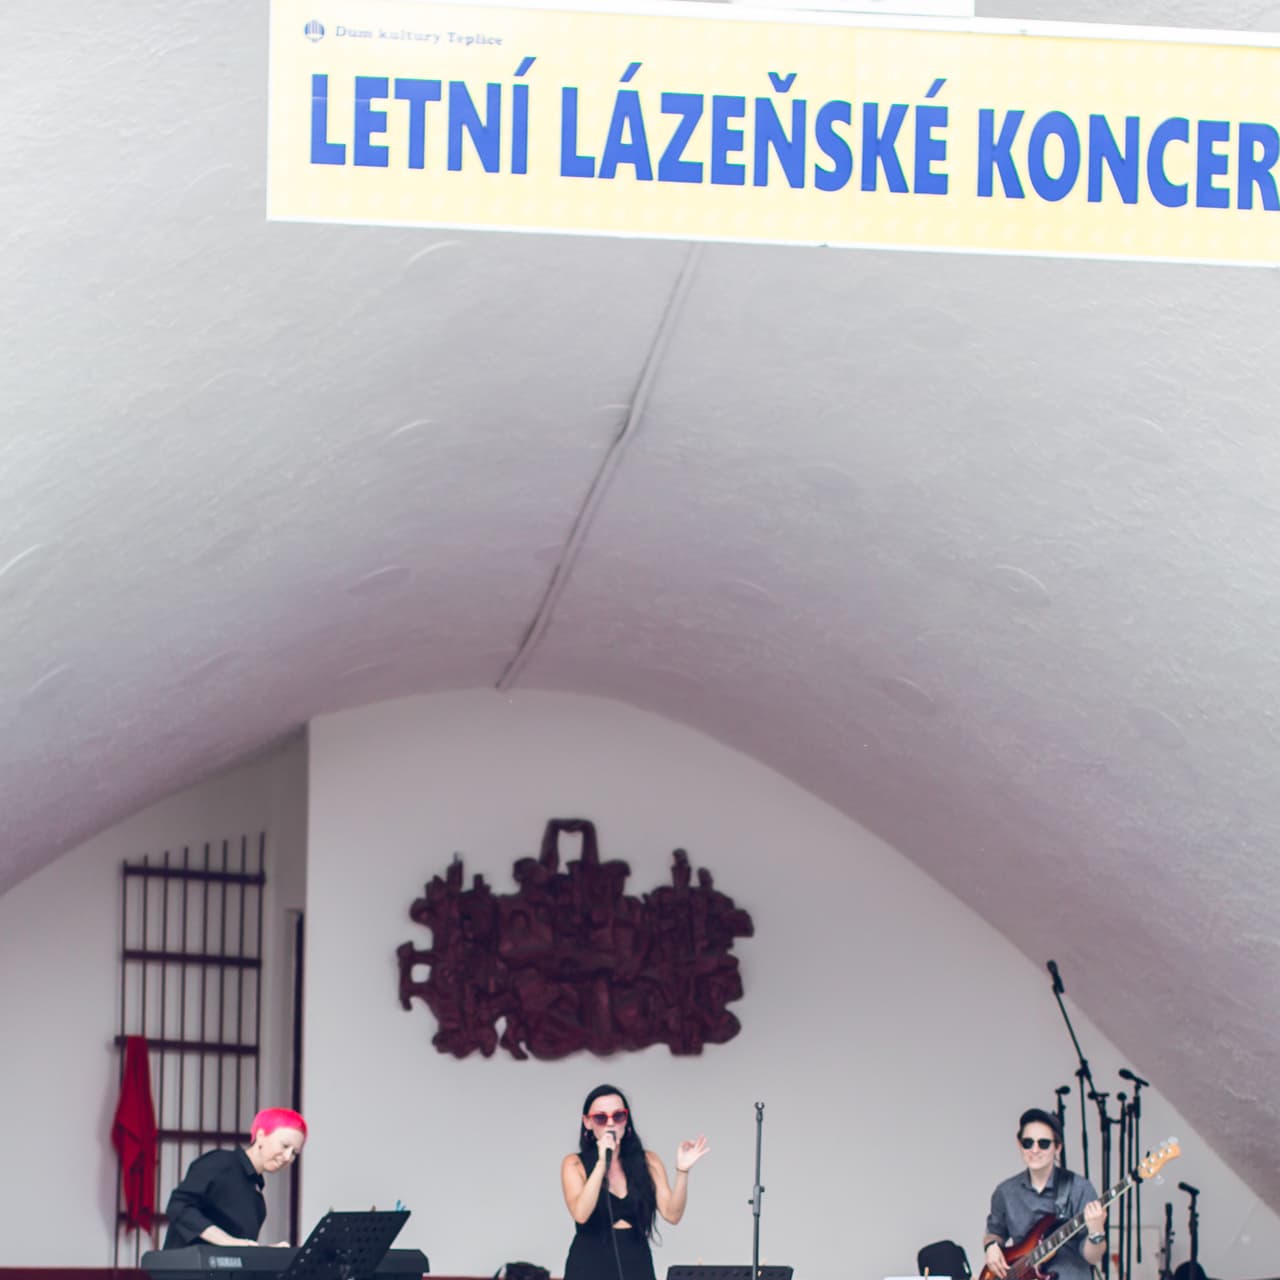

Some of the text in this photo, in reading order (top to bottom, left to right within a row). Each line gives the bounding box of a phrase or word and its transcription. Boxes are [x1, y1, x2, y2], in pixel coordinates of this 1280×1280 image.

[448, 31, 503, 47] Teplice
[311, 57, 535, 175] LETNÍ
[561, 62, 948, 195] LÁZEŇSKÉ
